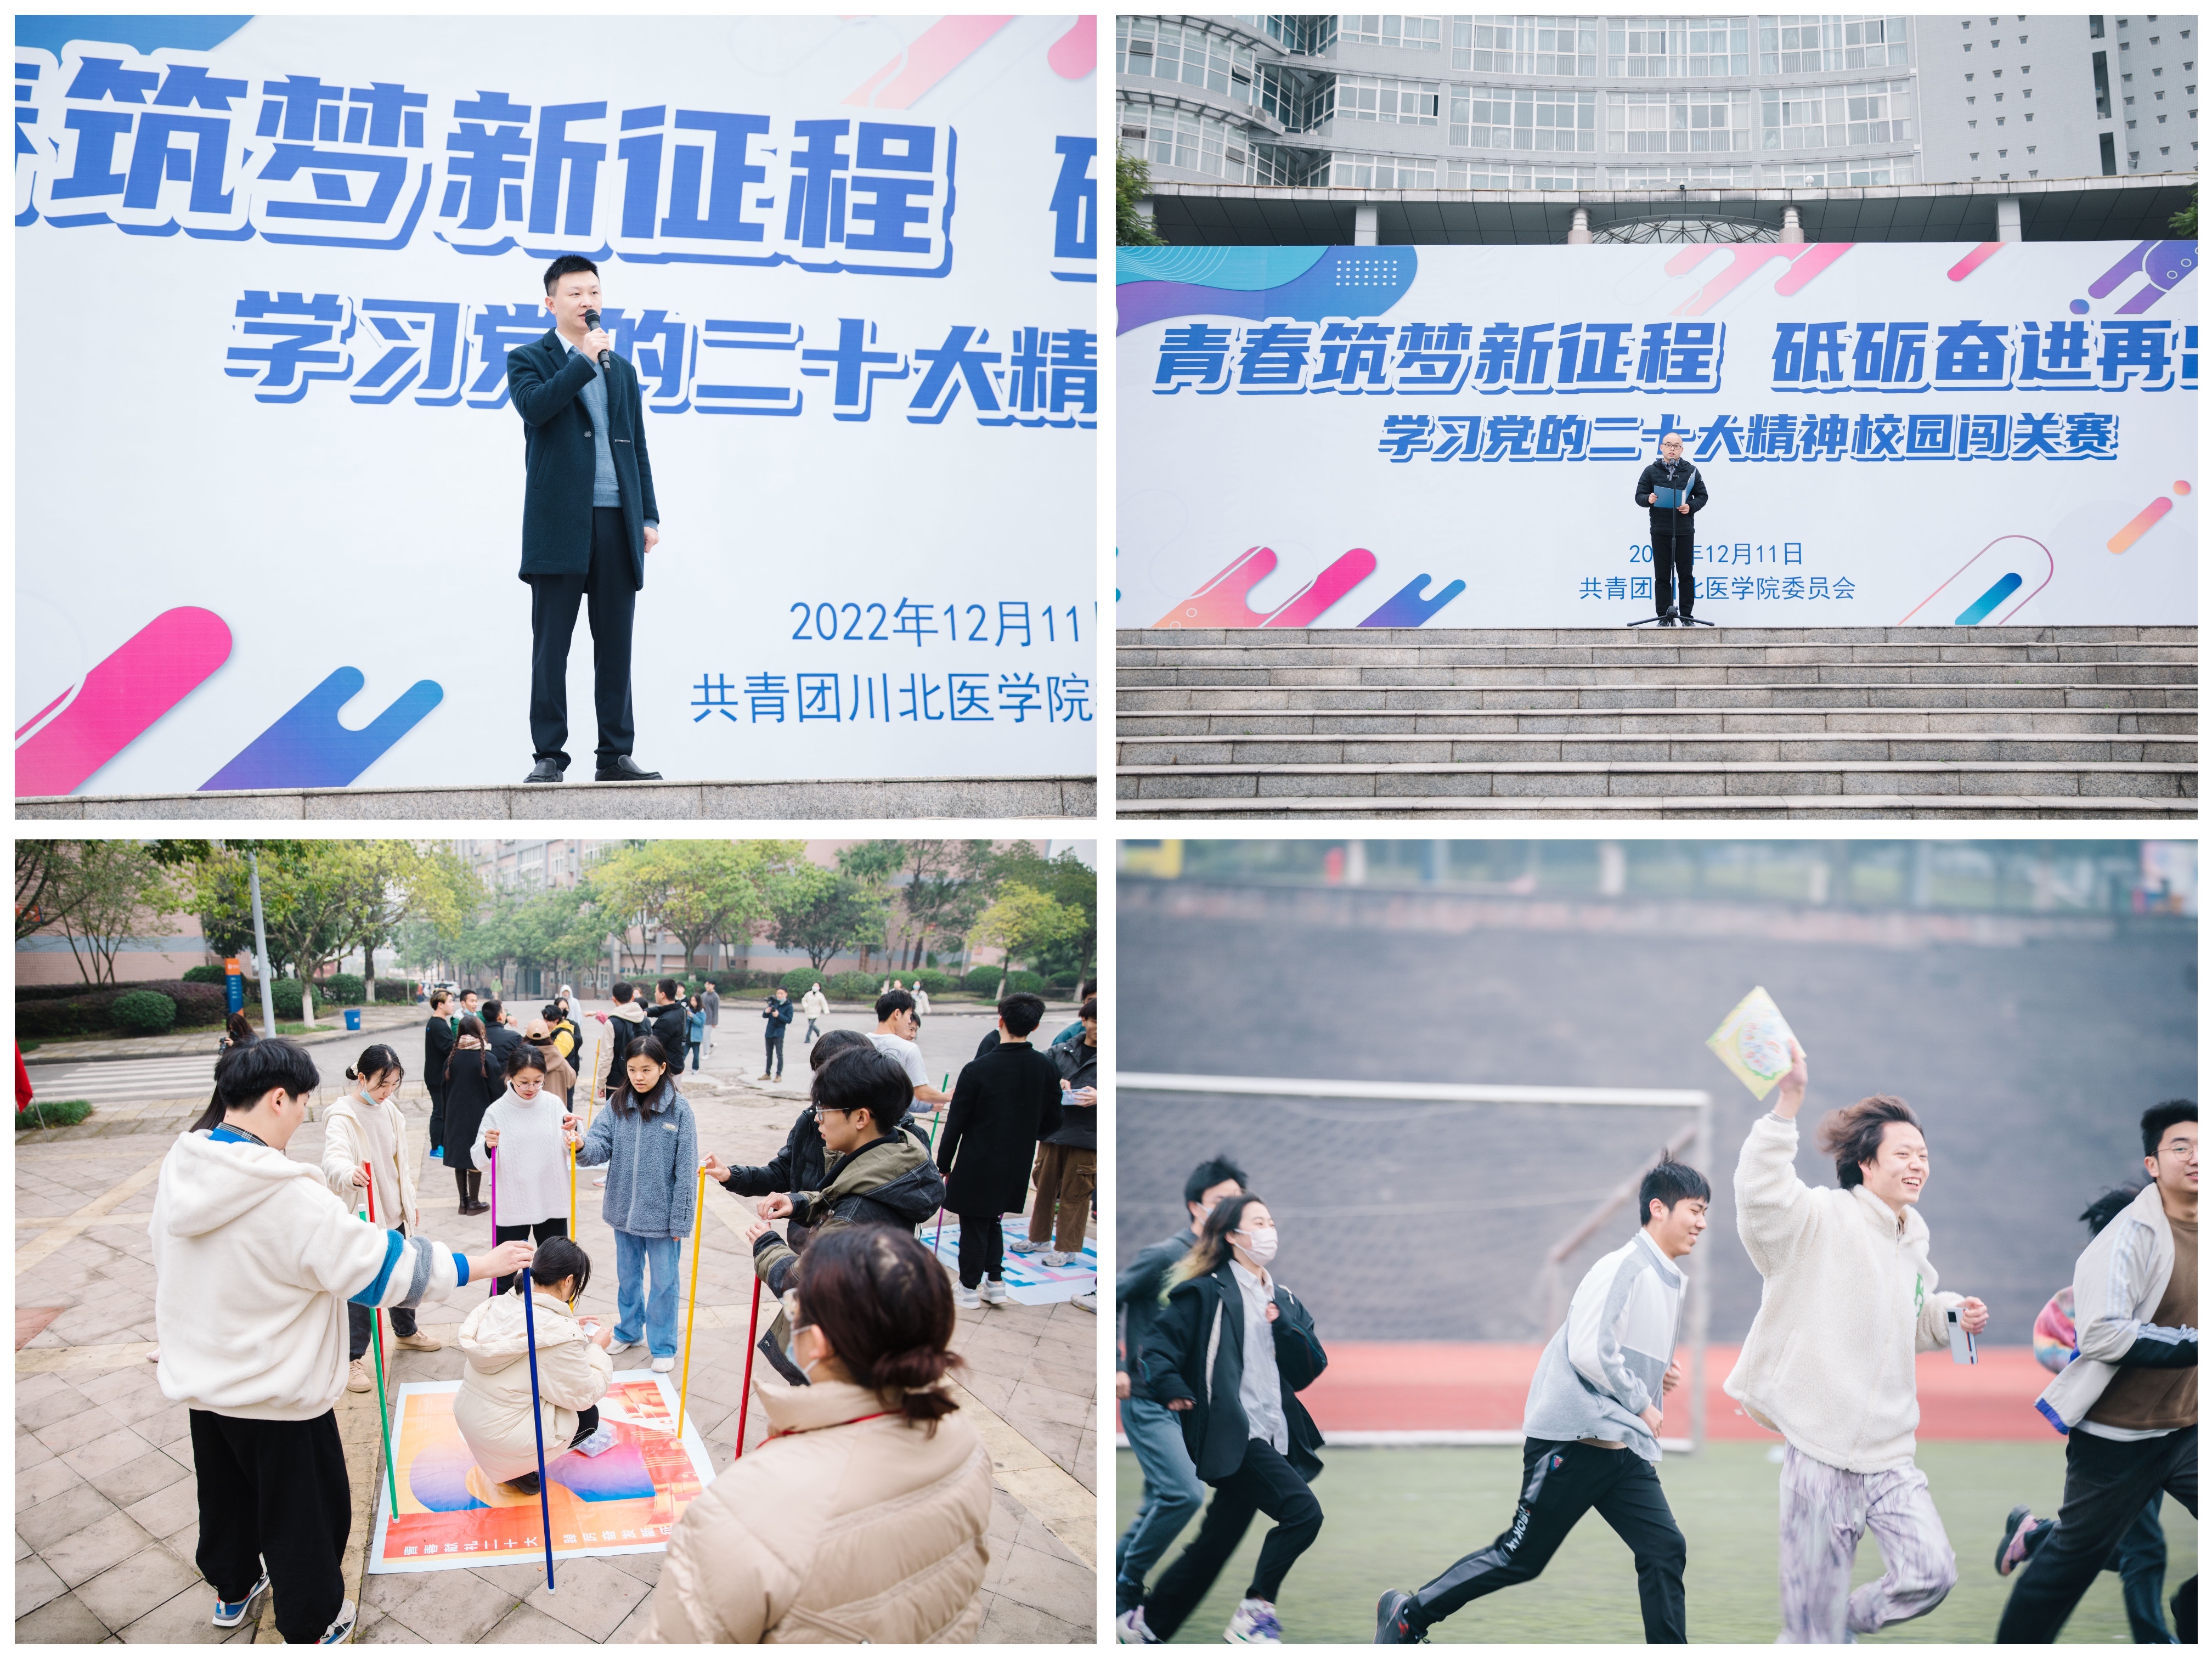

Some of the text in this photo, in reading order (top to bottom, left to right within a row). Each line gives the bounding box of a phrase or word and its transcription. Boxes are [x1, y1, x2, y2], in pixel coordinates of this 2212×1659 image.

[15, 57, 958, 278] 筑梦新征程
[1152, 319, 1726, 396] 青春筑梦新征程
[1378, 412, 2120, 464] 学习党的二十大精神校园闯关赛
[789, 597, 1097, 647] 2022年12月11
[691, 670, 1097, 724] 共青团川北医学院
[403, 1536, 538, 1556] 青春献礼二十大
